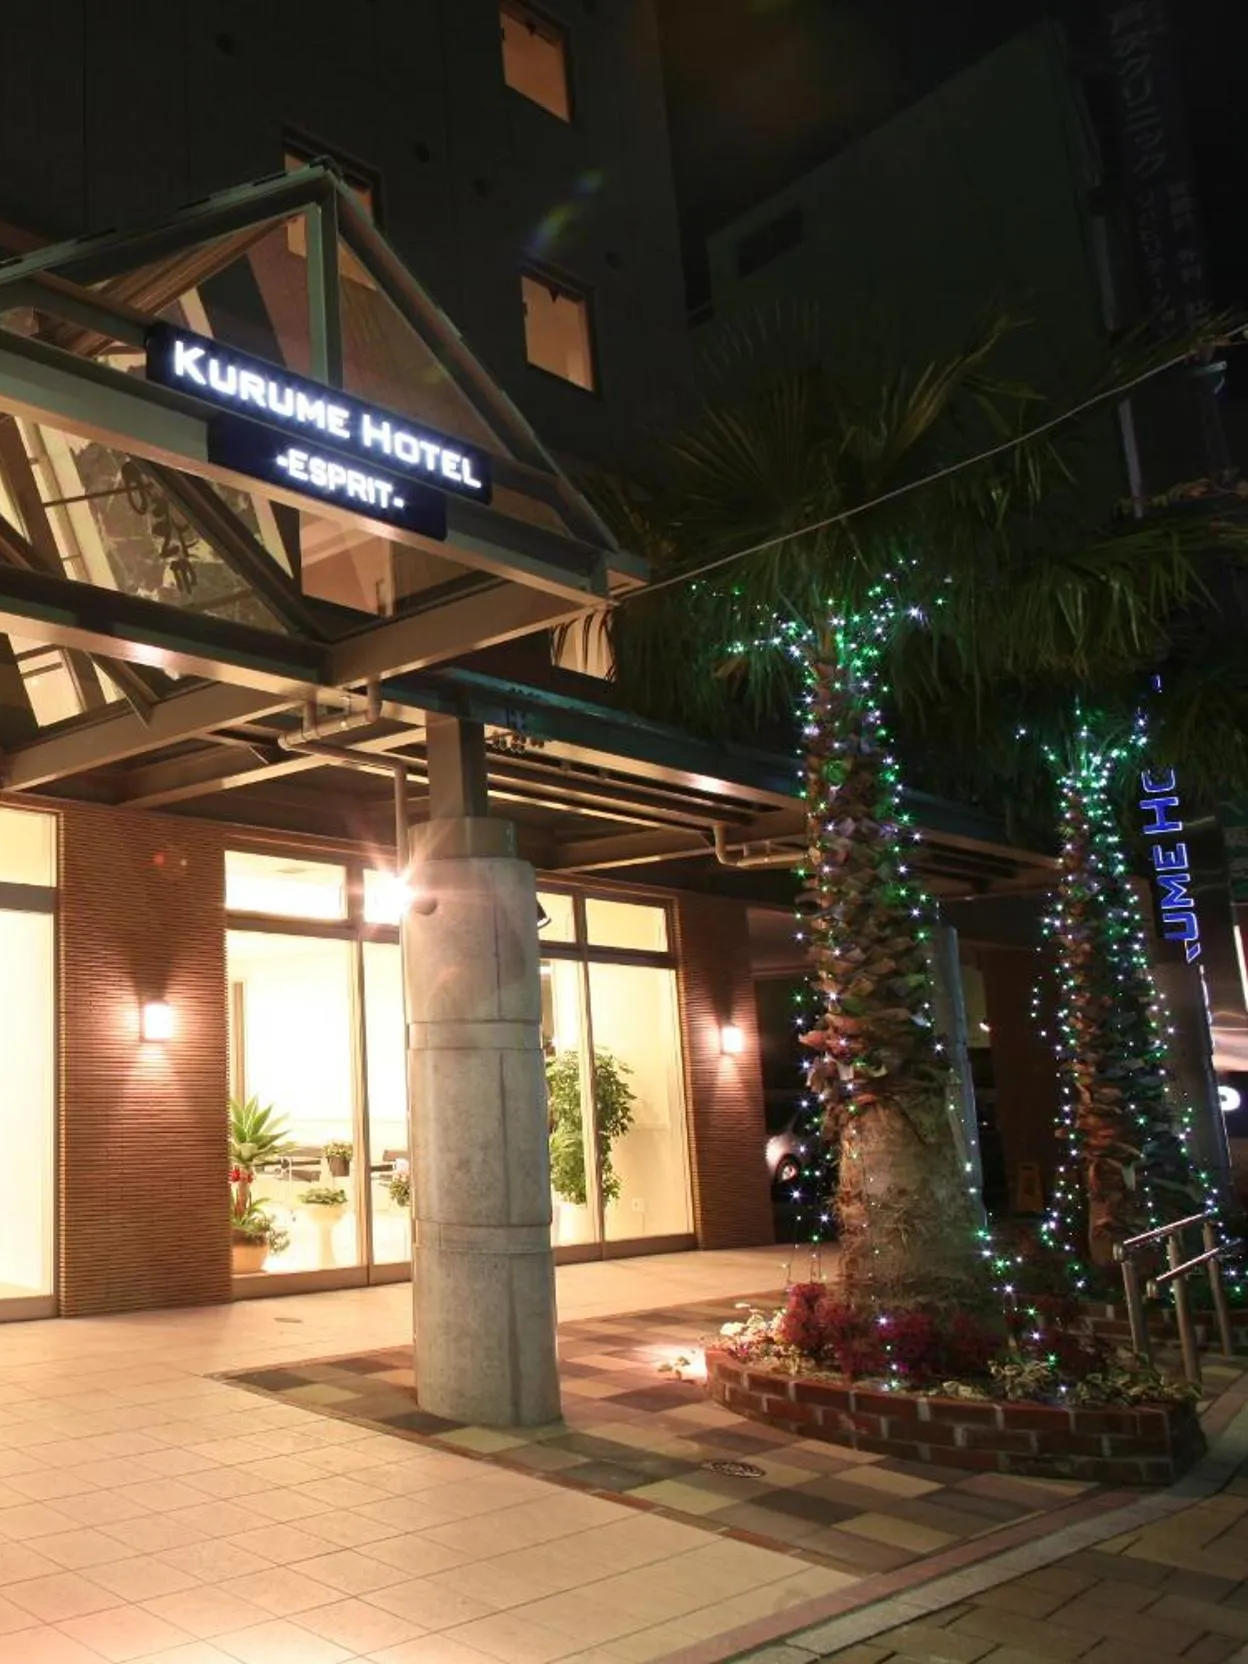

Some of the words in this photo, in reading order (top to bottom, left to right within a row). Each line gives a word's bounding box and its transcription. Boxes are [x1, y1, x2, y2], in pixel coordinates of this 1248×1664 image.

[173, 340, 351, 439] KURUME
[362, 413, 482, 489] HOTEL
[1152, 842, 1201, 964] UME
